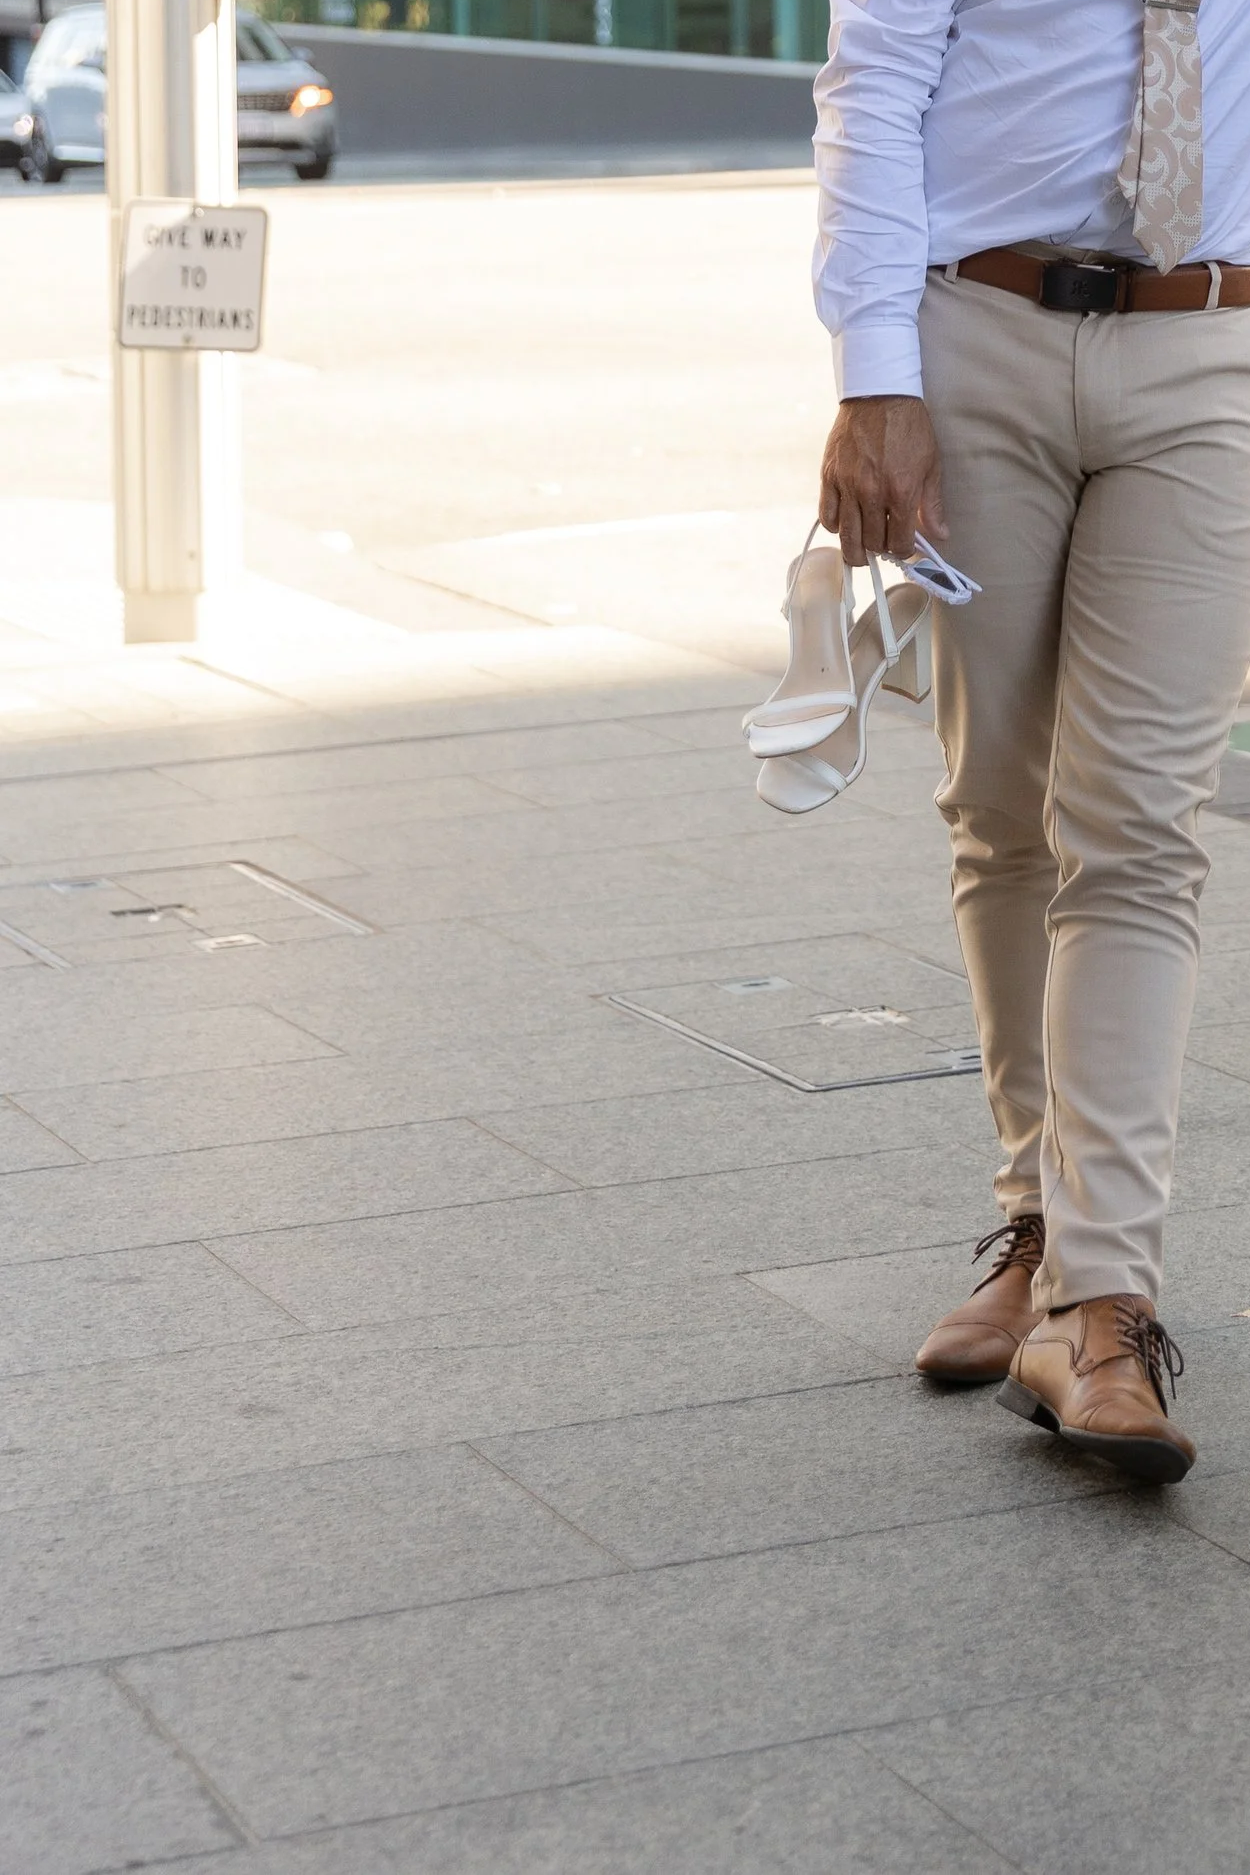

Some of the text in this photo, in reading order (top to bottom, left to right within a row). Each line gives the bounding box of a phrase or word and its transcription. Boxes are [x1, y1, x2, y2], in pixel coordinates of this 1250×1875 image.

[146, 226, 247, 250] GIVE WAY
[180, 265, 207, 290] TO
[127, 305, 254, 331] PEDESTRIANS
